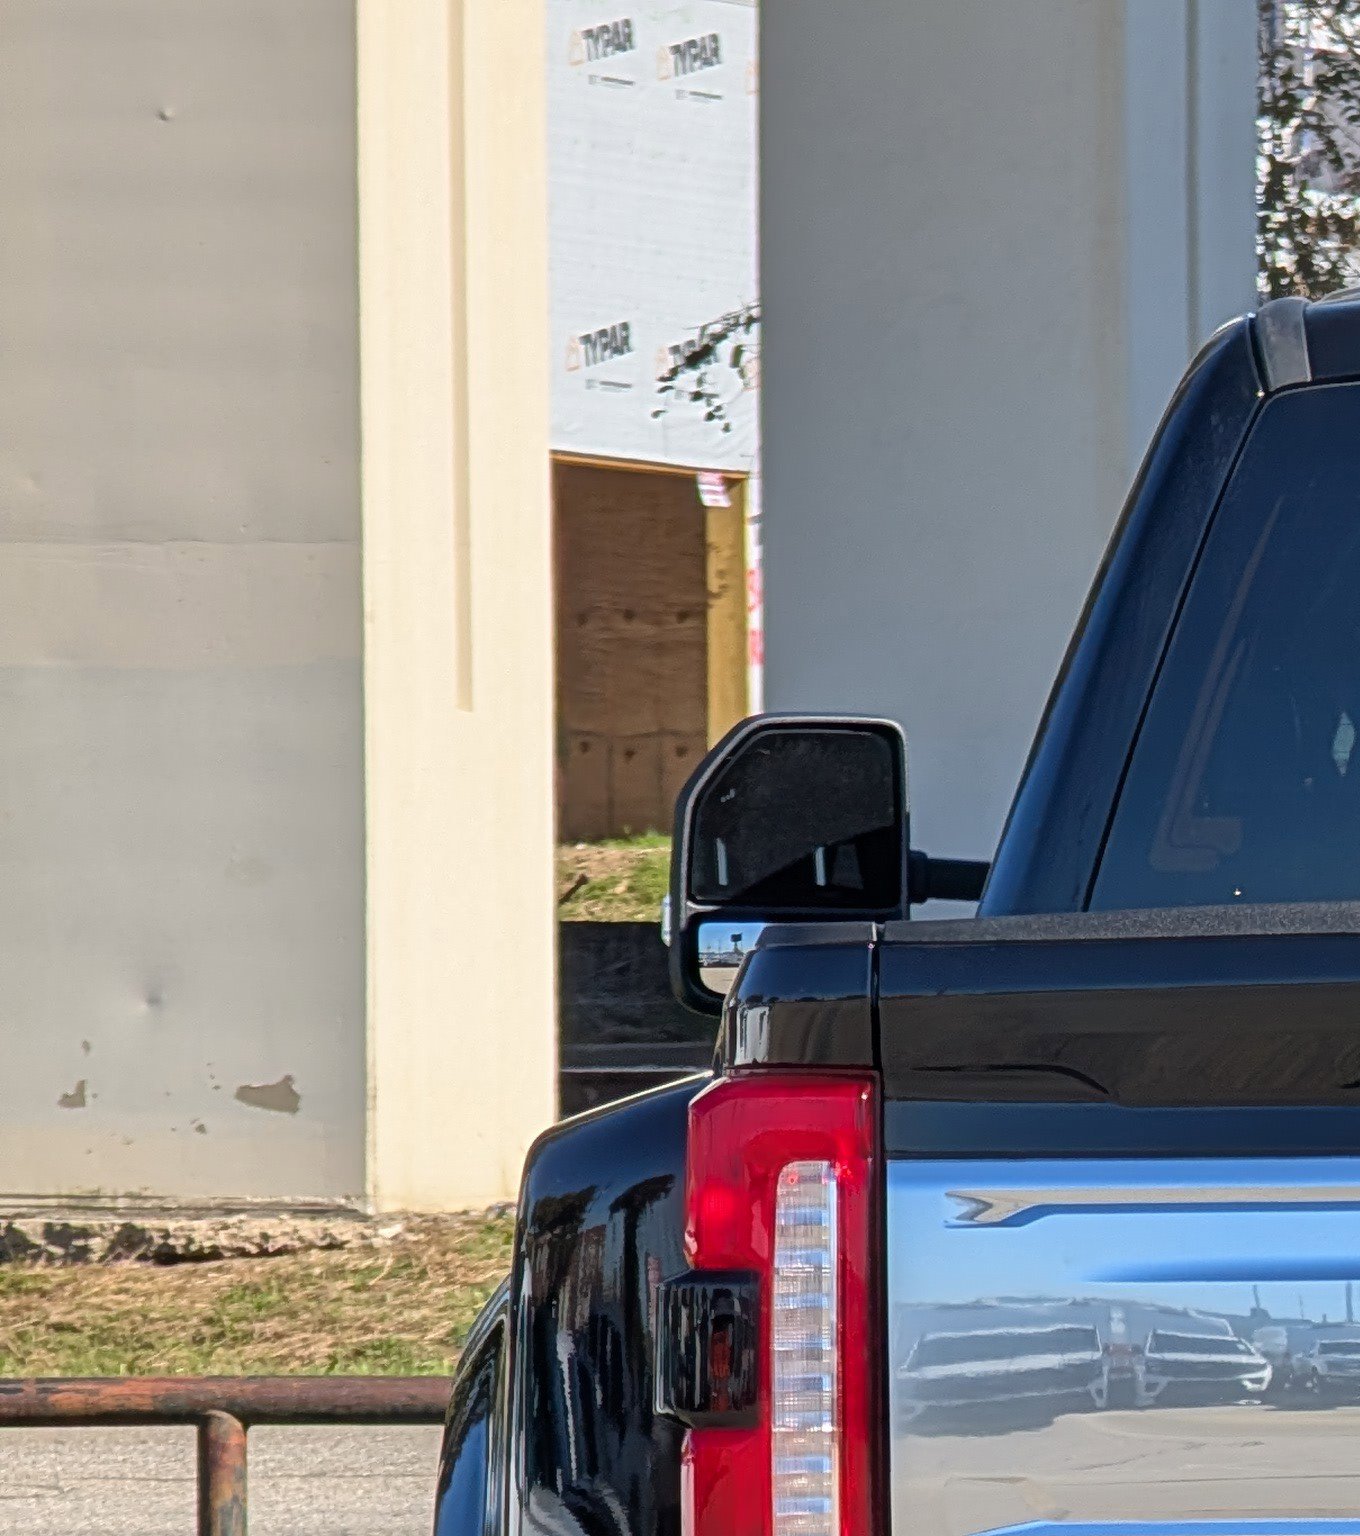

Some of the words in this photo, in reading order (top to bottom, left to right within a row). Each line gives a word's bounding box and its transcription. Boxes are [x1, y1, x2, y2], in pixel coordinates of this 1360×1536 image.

[581, 18, 636, 62] TYPAR
[668, 33, 723, 77] TYPAR
[579, 321, 633, 366] TYPAR
